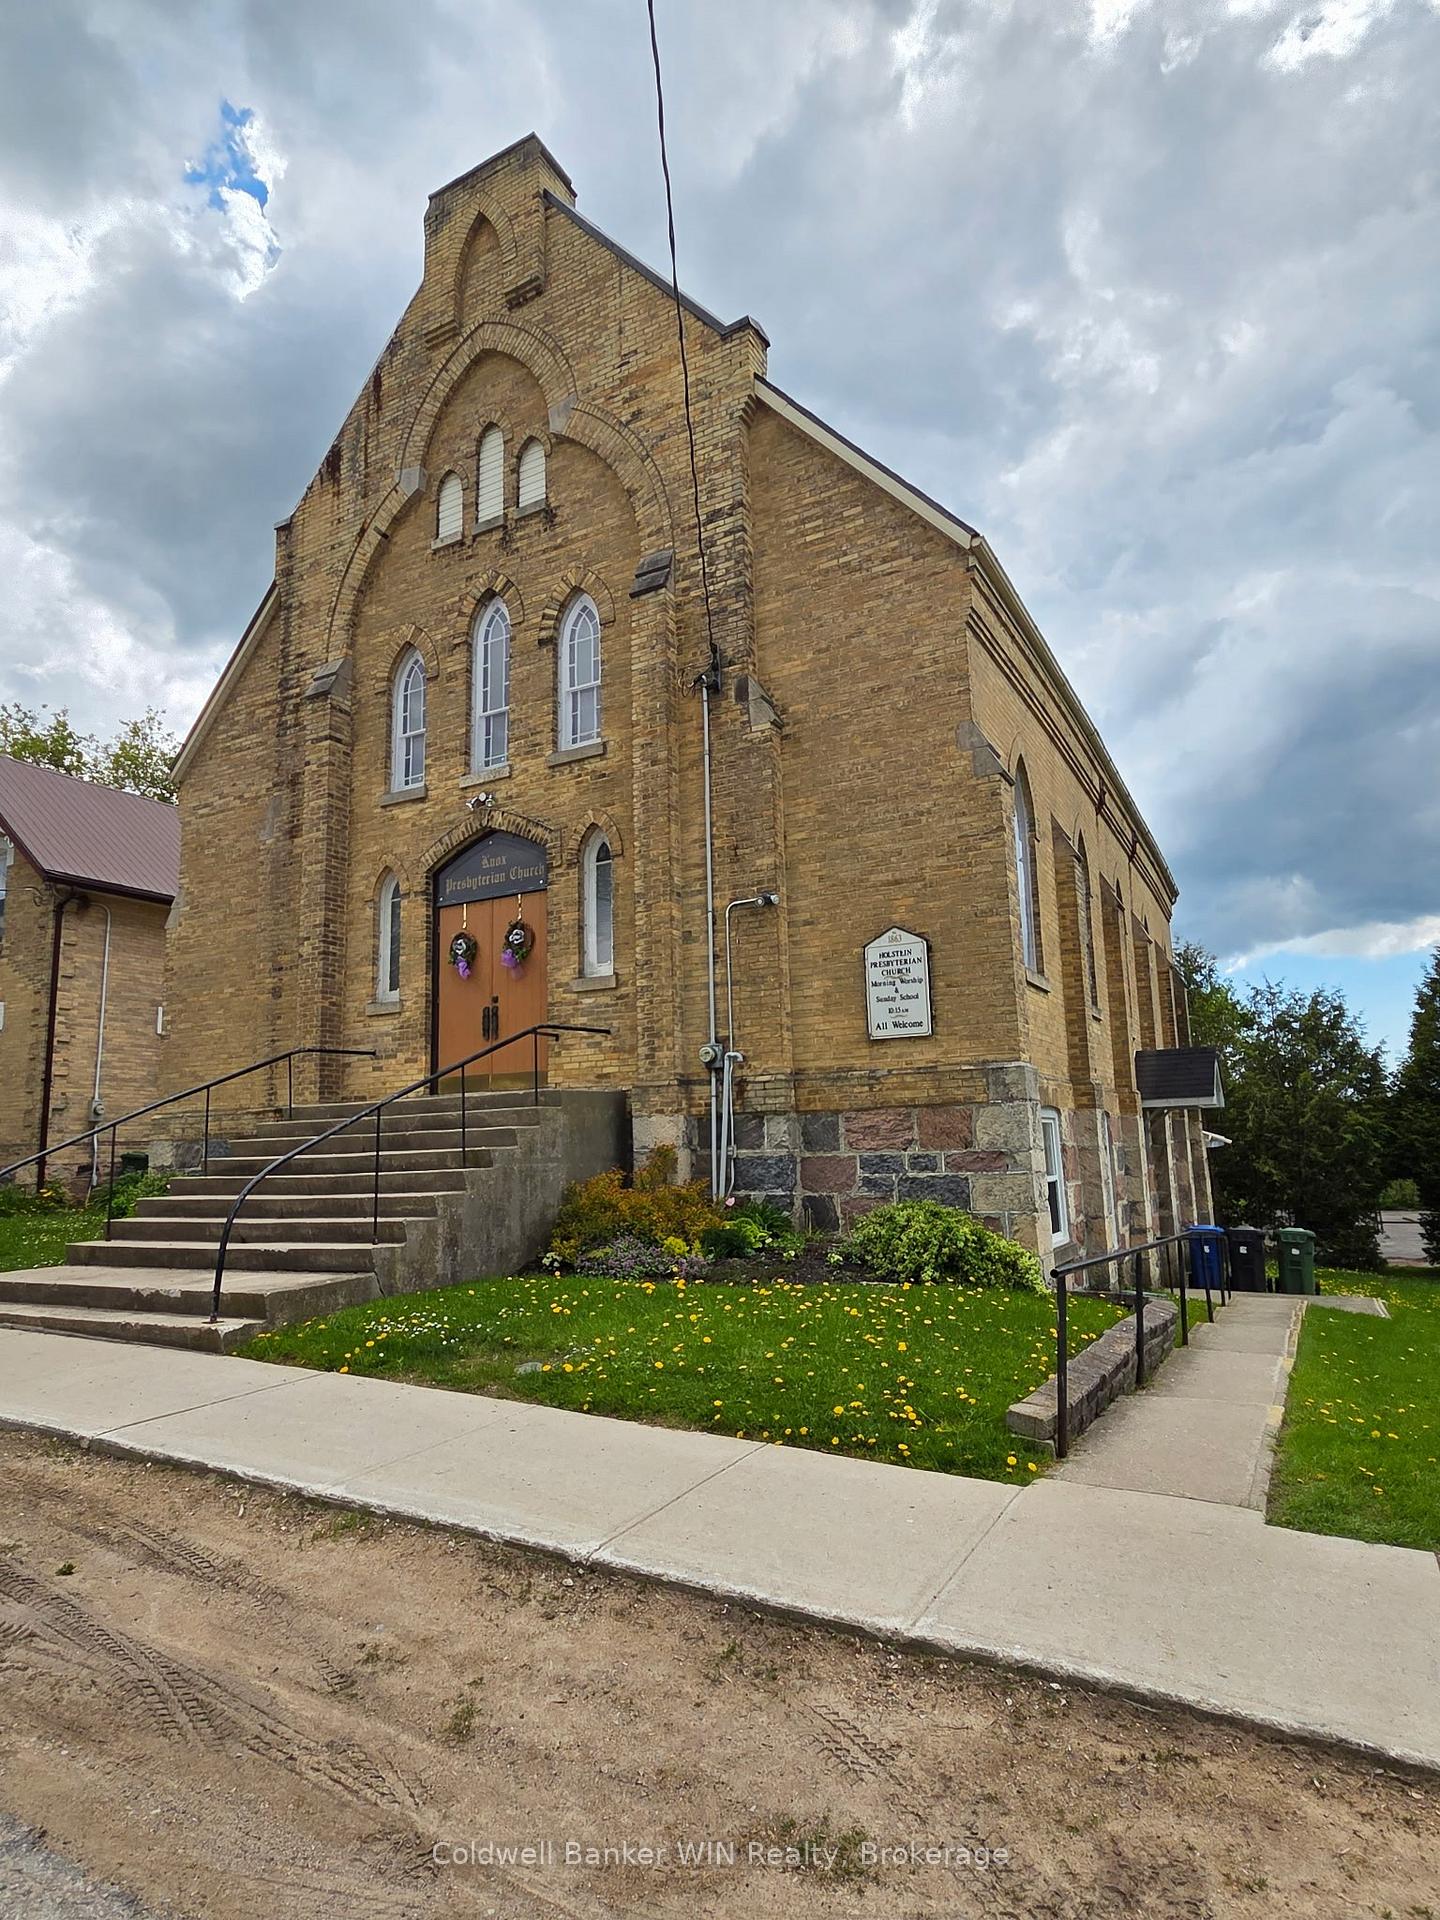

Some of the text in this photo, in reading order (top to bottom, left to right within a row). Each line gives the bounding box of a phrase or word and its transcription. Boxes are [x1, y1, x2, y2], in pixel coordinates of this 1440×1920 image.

[481, 855, 507, 868] Knox
[446, 864, 545, 894] Presbyterian Church
[879, 949, 912, 959] HOLSTEIN
[870, 957, 922, 968] PRESBYTERIAN
[881, 967, 911, 976] CHURCH
[900, 993, 919, 1001] School
[875, 1020, 923, 1030] All Welcome
